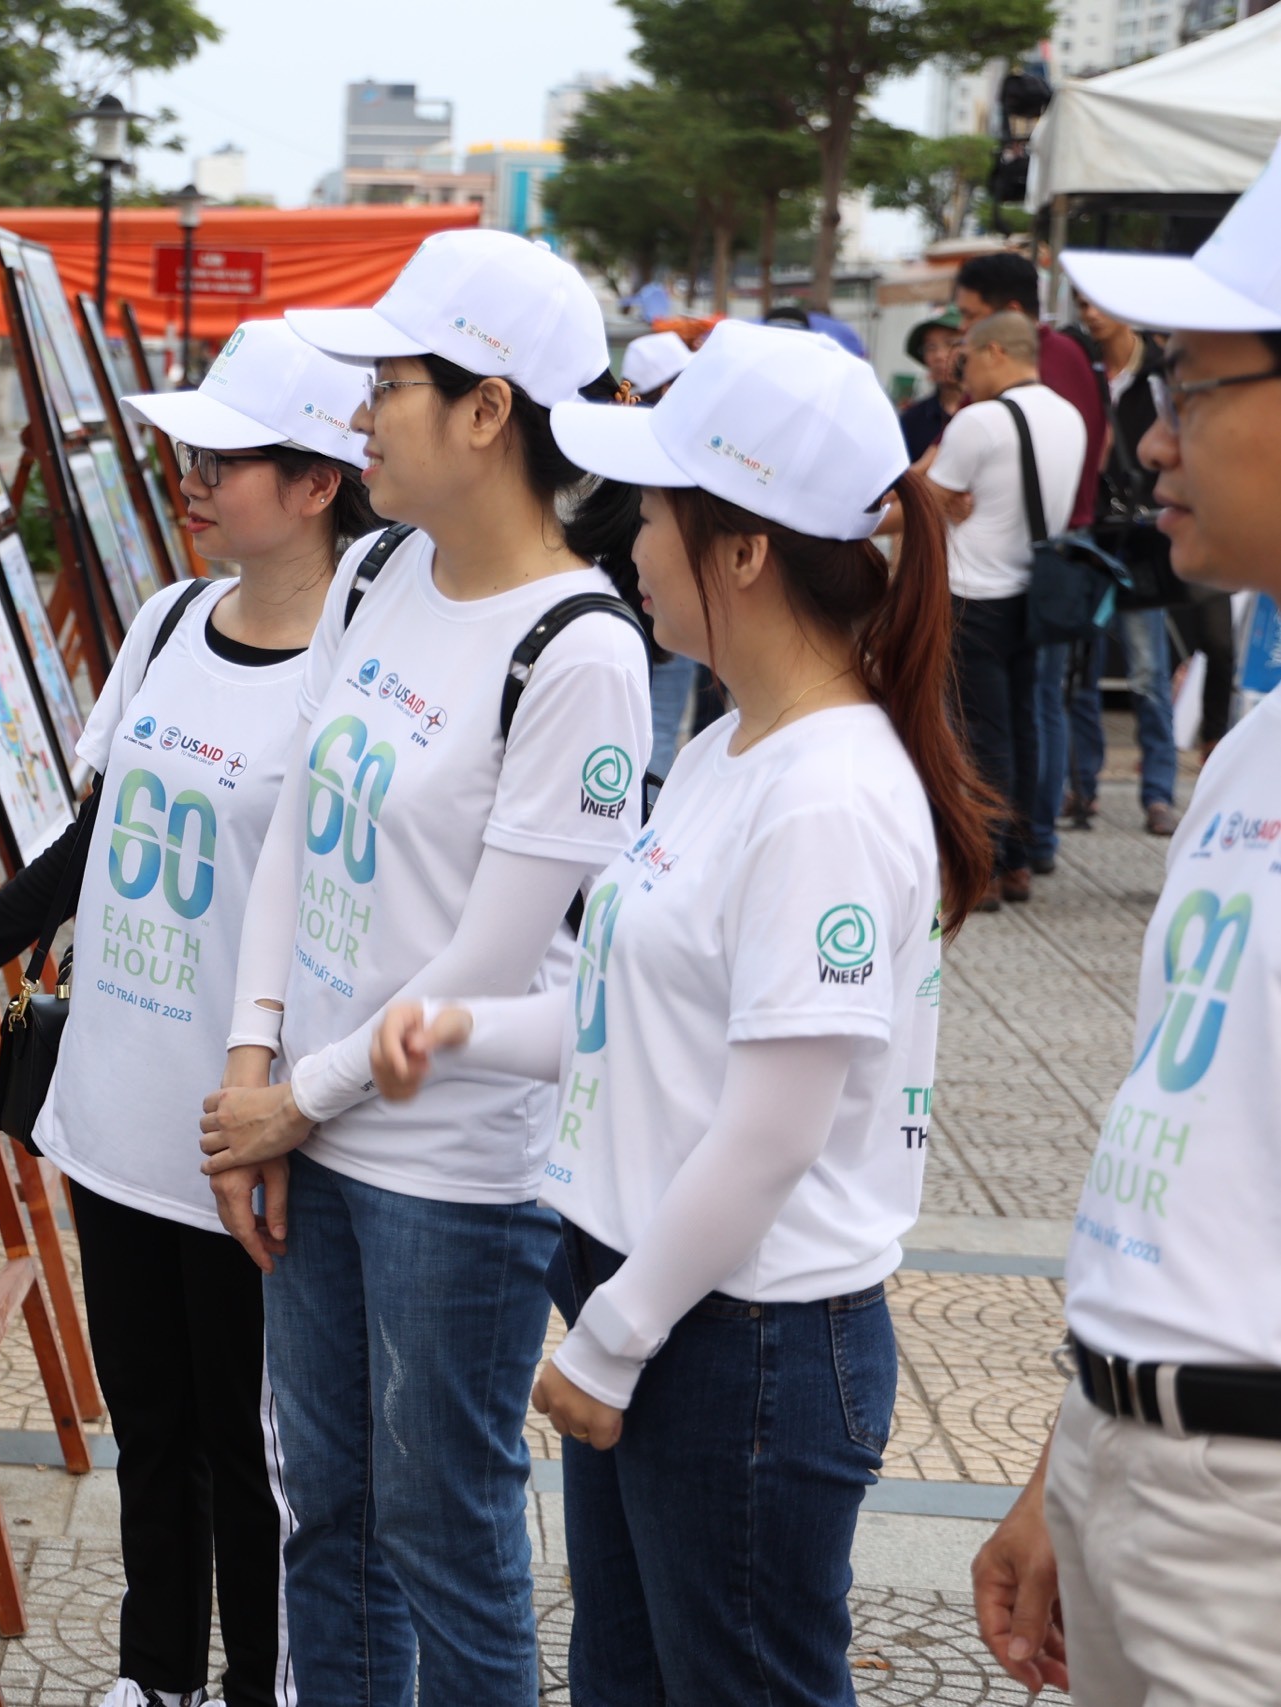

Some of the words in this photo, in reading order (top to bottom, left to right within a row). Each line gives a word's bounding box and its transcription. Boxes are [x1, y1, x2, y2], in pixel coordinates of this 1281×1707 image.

[477, 331, 501, 349] USAID
[324, 414, 346, 429] USAID
[734, 450, 761, 470] USAID
[394, 683, 426, 715] USAID
[180, 736, 224, 762] USAID
[410, 731, 429, 748] EVN
[218, 777, 236, 789] EVN
[306, 714, 396, 884] 60
[581, 786, 626, 820] VNEEP
[108, 768, 216, 920] 60
[303, 869, 372, 934] ARTH
[102, 904, 201, 964] EARTH
[103, 937, 197, 995] HOUR
[817, 955, 873, 985] VNEEP
[97, 979, 115, 995] GIỜ
[116, 987, 138, 1005] TRÁI
[140, 997, 161, 1013] ĐẤT
[162, 1005, 193, 1022] 2023
[330, 976, 354, 998] 2023
[1088, 1152, 1169, 1219] OUR
